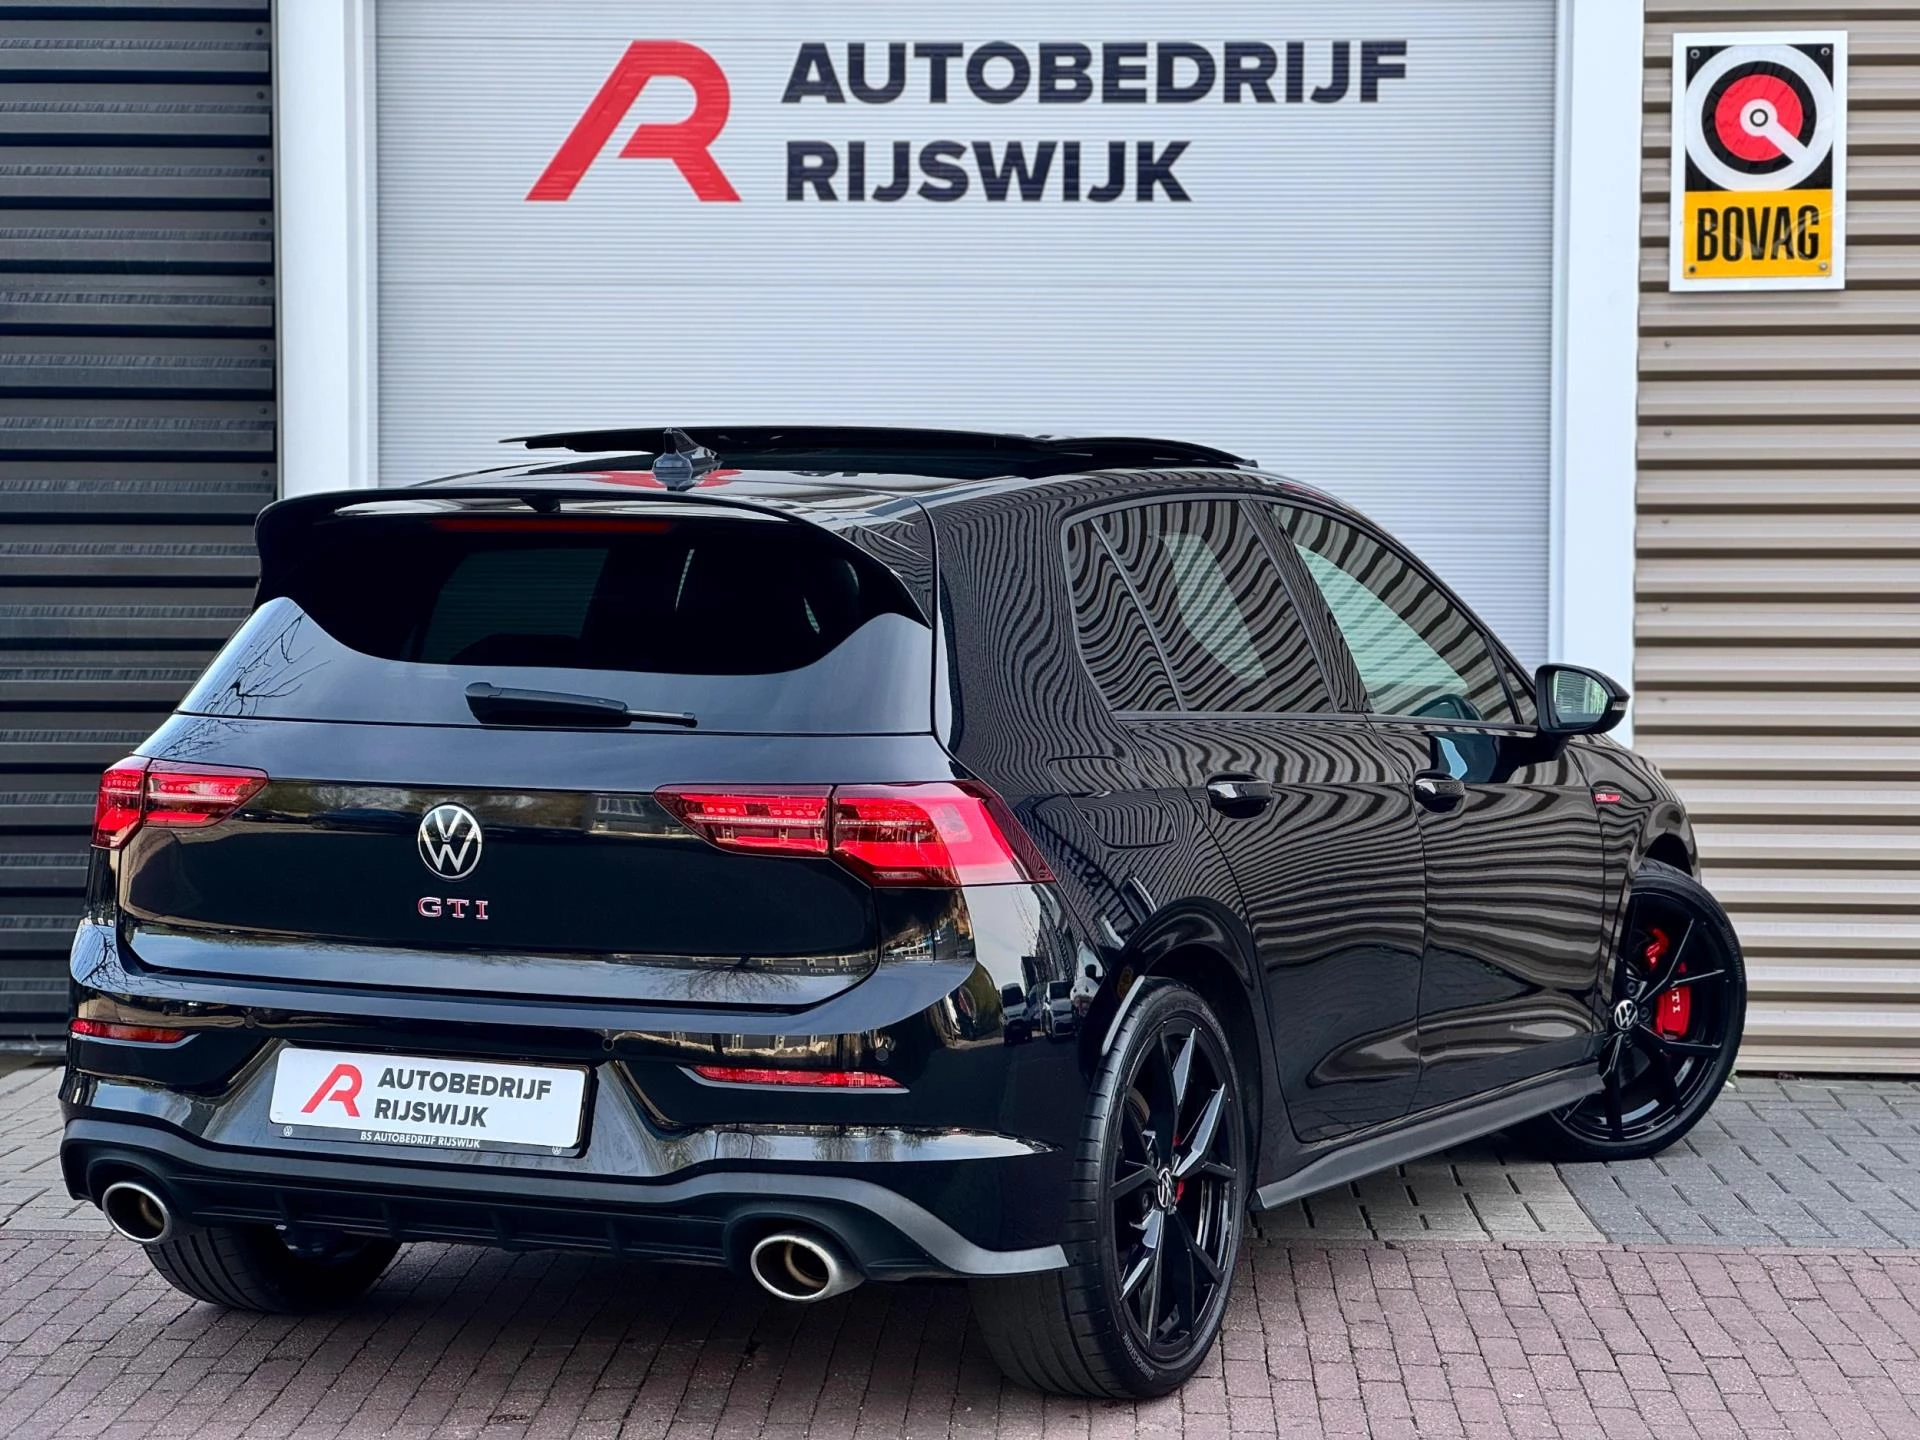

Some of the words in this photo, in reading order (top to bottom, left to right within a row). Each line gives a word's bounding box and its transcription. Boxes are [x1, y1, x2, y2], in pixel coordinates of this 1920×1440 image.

[781, 40, 1407, 104] AUTOBEDRIJF
[786, 140, 1192, 203] RIJSWIJK
[1696, 204, 1820, 262] BOVAG
[417, 896, 489, 920] GTI
[376, 1067, 553, 1101] AUTOBEDRIJF
[373, 1098, 490, 1128] RIJSWIJK
[360, 1131, 372, 1141] BS
[374, 1131, 437, 1146] AUTOBEDRIJF
[437, 1136, 481, 1149] RIJSWIJK
